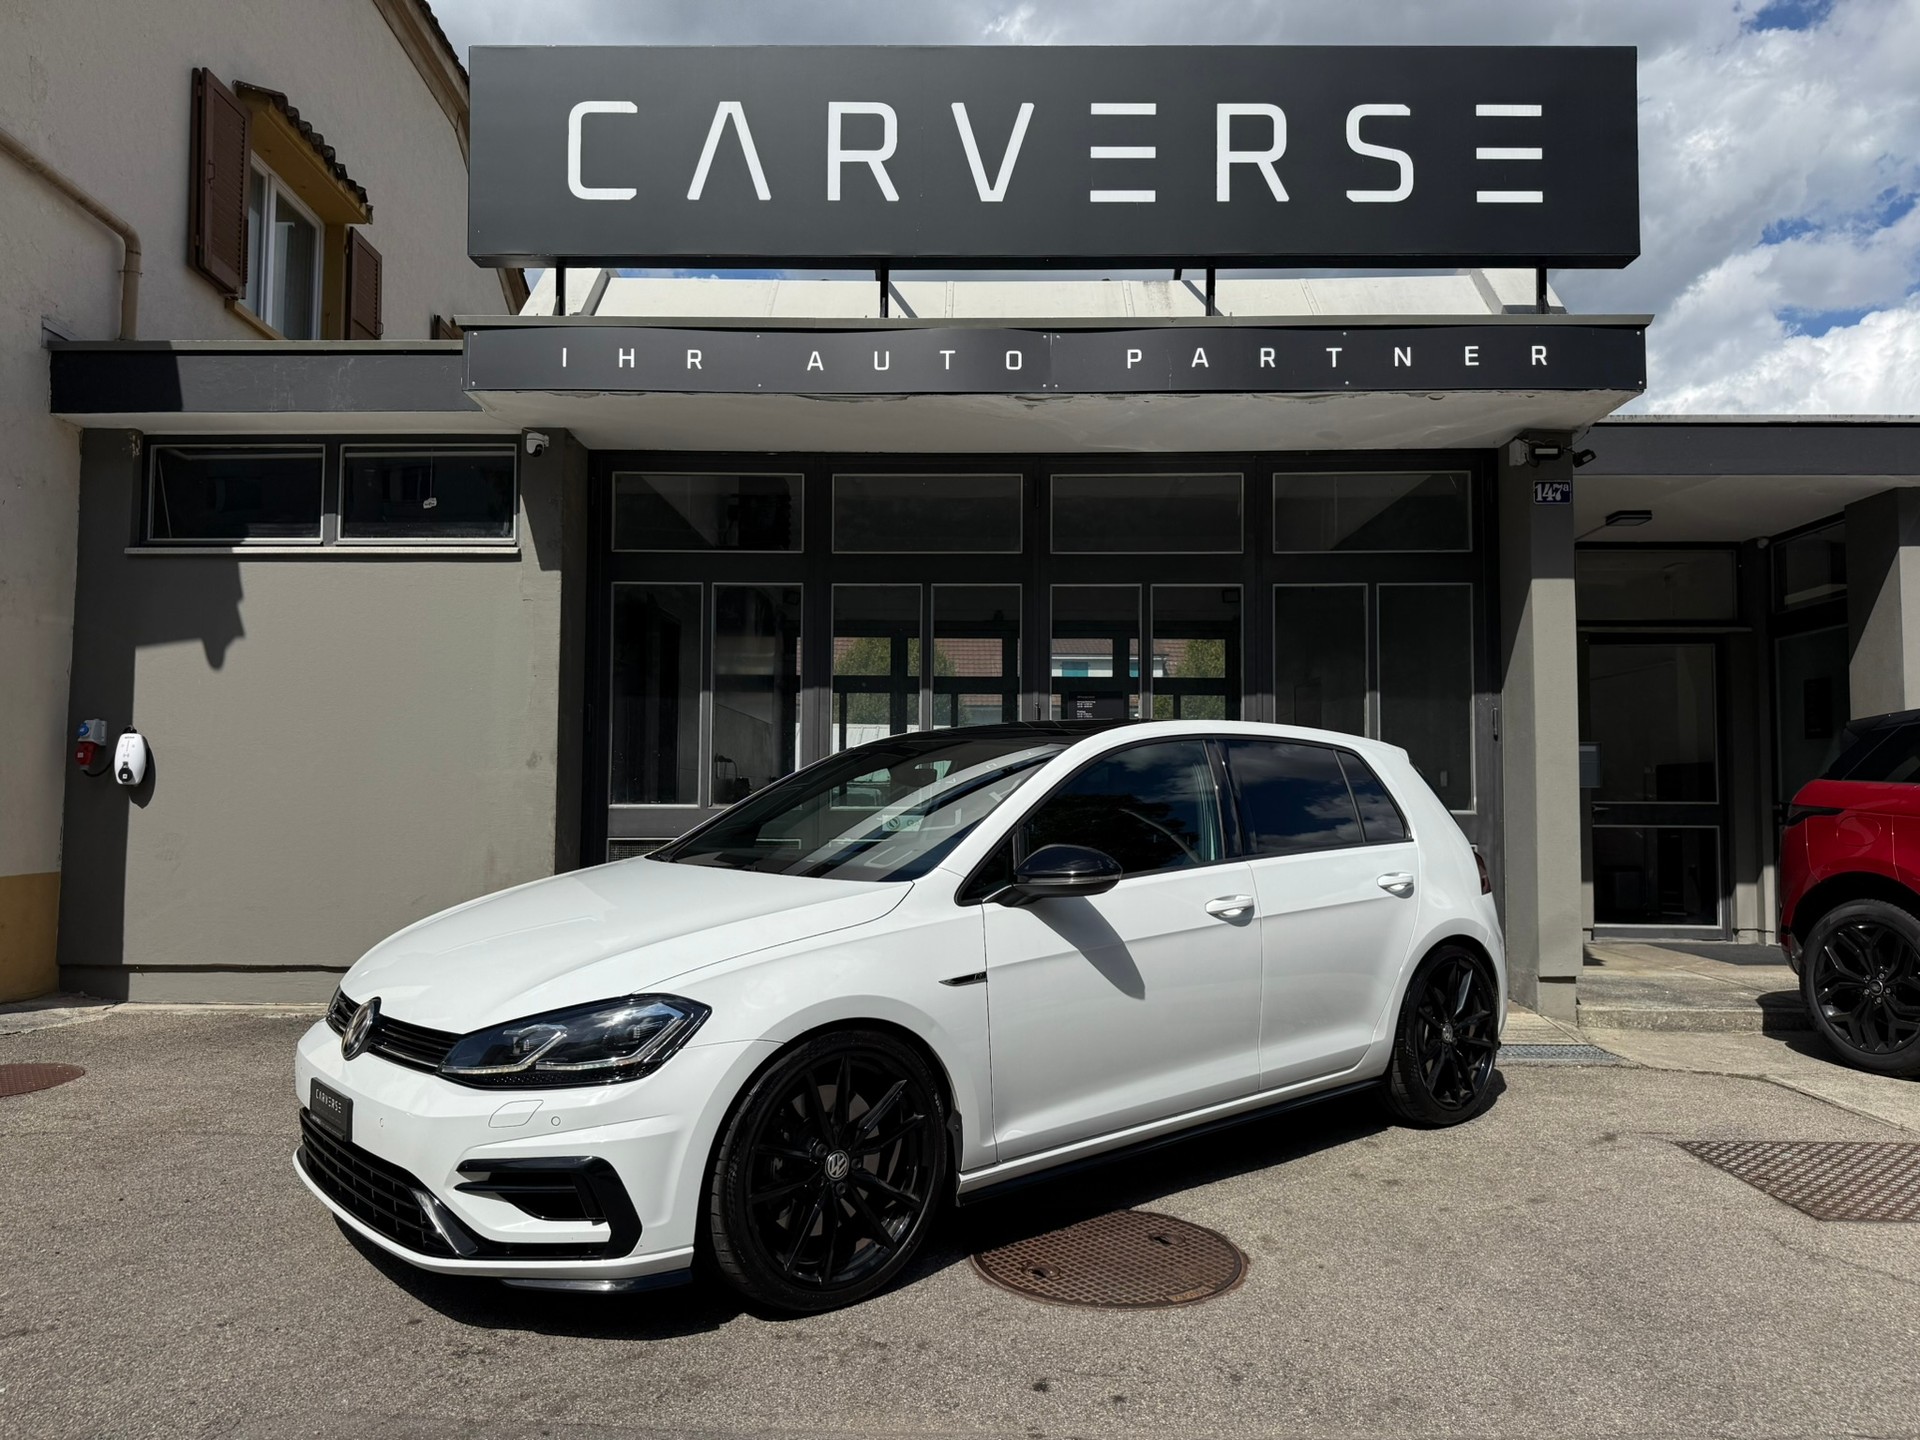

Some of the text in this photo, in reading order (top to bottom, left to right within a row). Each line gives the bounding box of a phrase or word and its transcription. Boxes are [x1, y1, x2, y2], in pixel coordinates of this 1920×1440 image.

[568, 101, 1543, 203] CARVERSE
[562, 345, 1548, 372] IHR AUTO PARTNER
[1535, 483, 1569, 501] 147a
